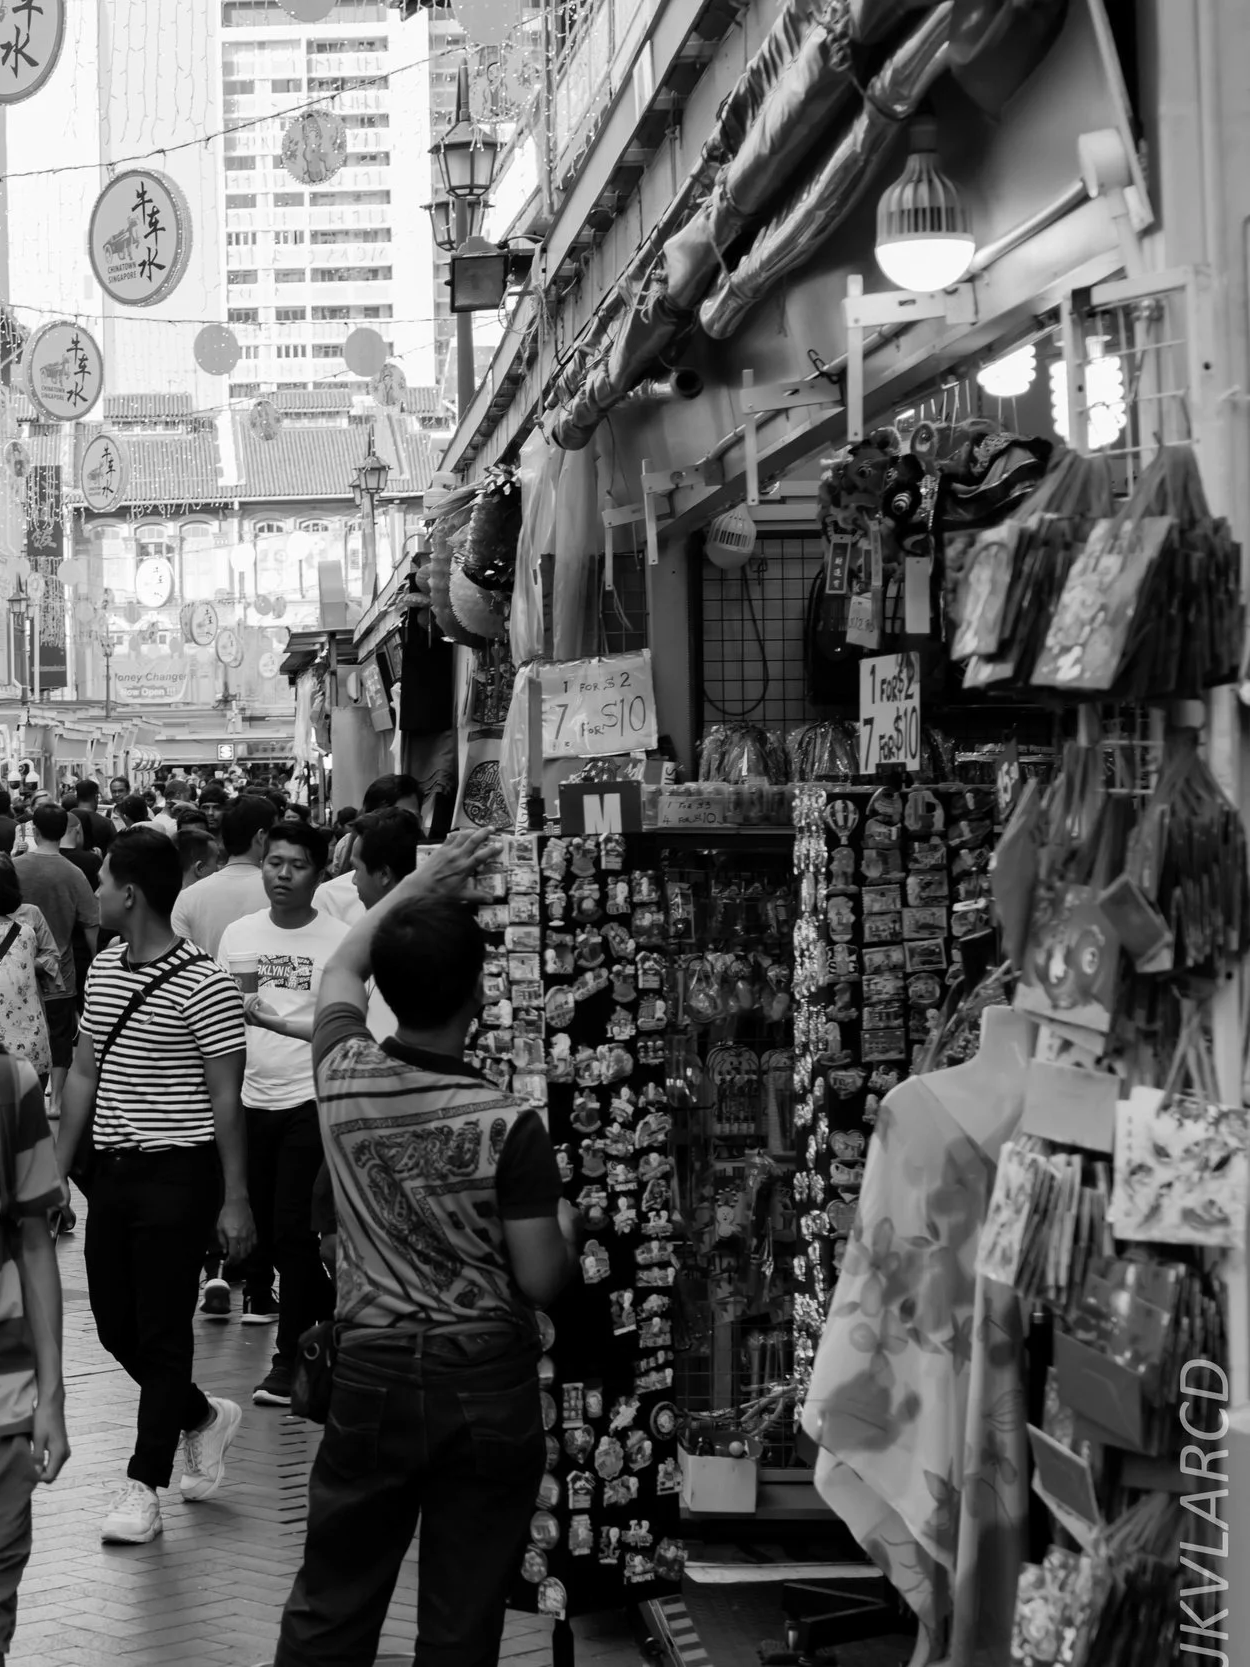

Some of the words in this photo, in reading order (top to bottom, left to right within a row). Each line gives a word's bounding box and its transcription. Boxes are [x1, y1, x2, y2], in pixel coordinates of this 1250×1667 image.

[108, 271, 137, 283] SINGAPORE
[562, 680, 569, 694] 1
[579, 682, 601, 693] FOR
[869, 663, 876, 705] 1
[880, 677, 898, 702] FOR
[550, 703, 569, 740] 7
[863, 716, 874, 772] 7
[894, 706, 918, 761] $10
[582, 793, 622, 835] M
